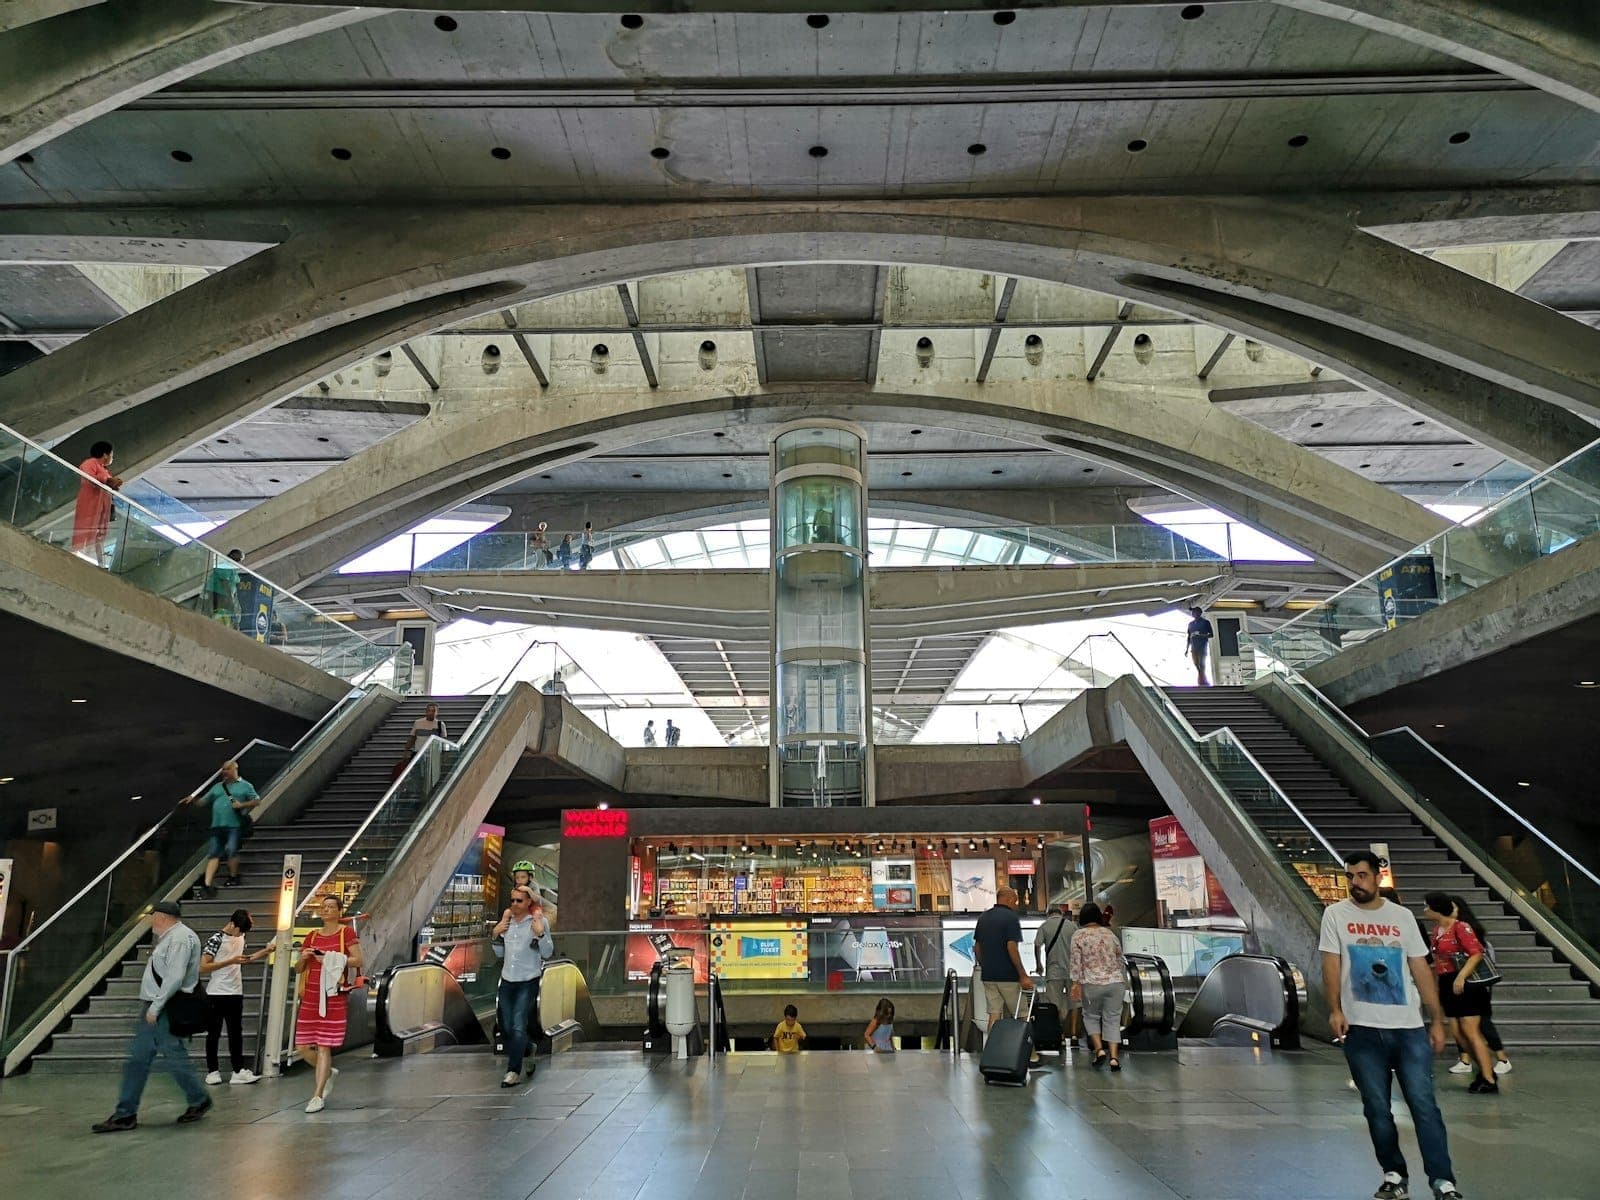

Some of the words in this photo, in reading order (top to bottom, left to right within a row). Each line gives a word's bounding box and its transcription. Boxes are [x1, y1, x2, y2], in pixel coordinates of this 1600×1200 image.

[1401, 565, 1430, 574] ATM
[1346, 922, 1401, 937] GNAWS
[851, 941, 884, 950] Galaxy
